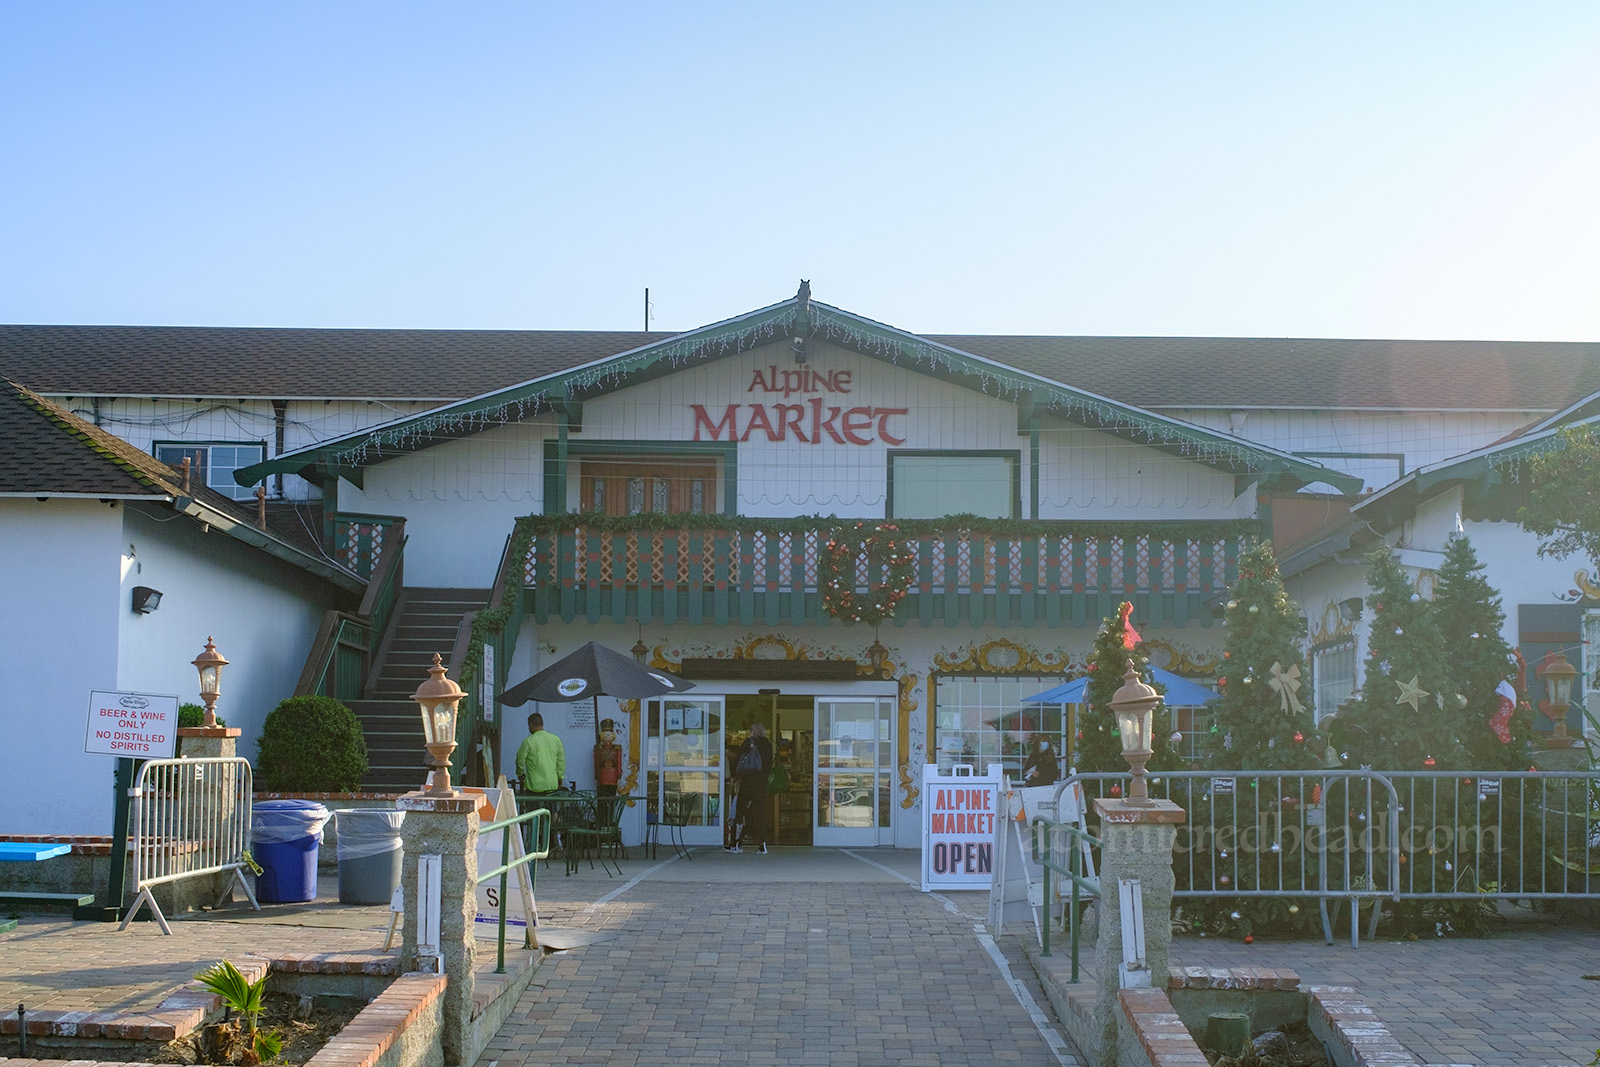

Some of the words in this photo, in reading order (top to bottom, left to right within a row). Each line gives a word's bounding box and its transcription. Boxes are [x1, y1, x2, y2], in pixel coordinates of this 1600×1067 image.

[100, 708, 128, 718] BEER
[130, 711, 137, 719] &
[140, 711, 166, 721] WINE
[118, 719, 147, 729] ONLY
[943, 717, 951, 727] A
[95, 730, 111, 739] NO
[114, 731, 165, 743] DISTILLED
[110, 741, 150, 752] SPIRITS
[936, 789, 991, 810] ALPINE
[931, 813, 995, 834] MARKET
[932, 841, 993, 875] OPEN
